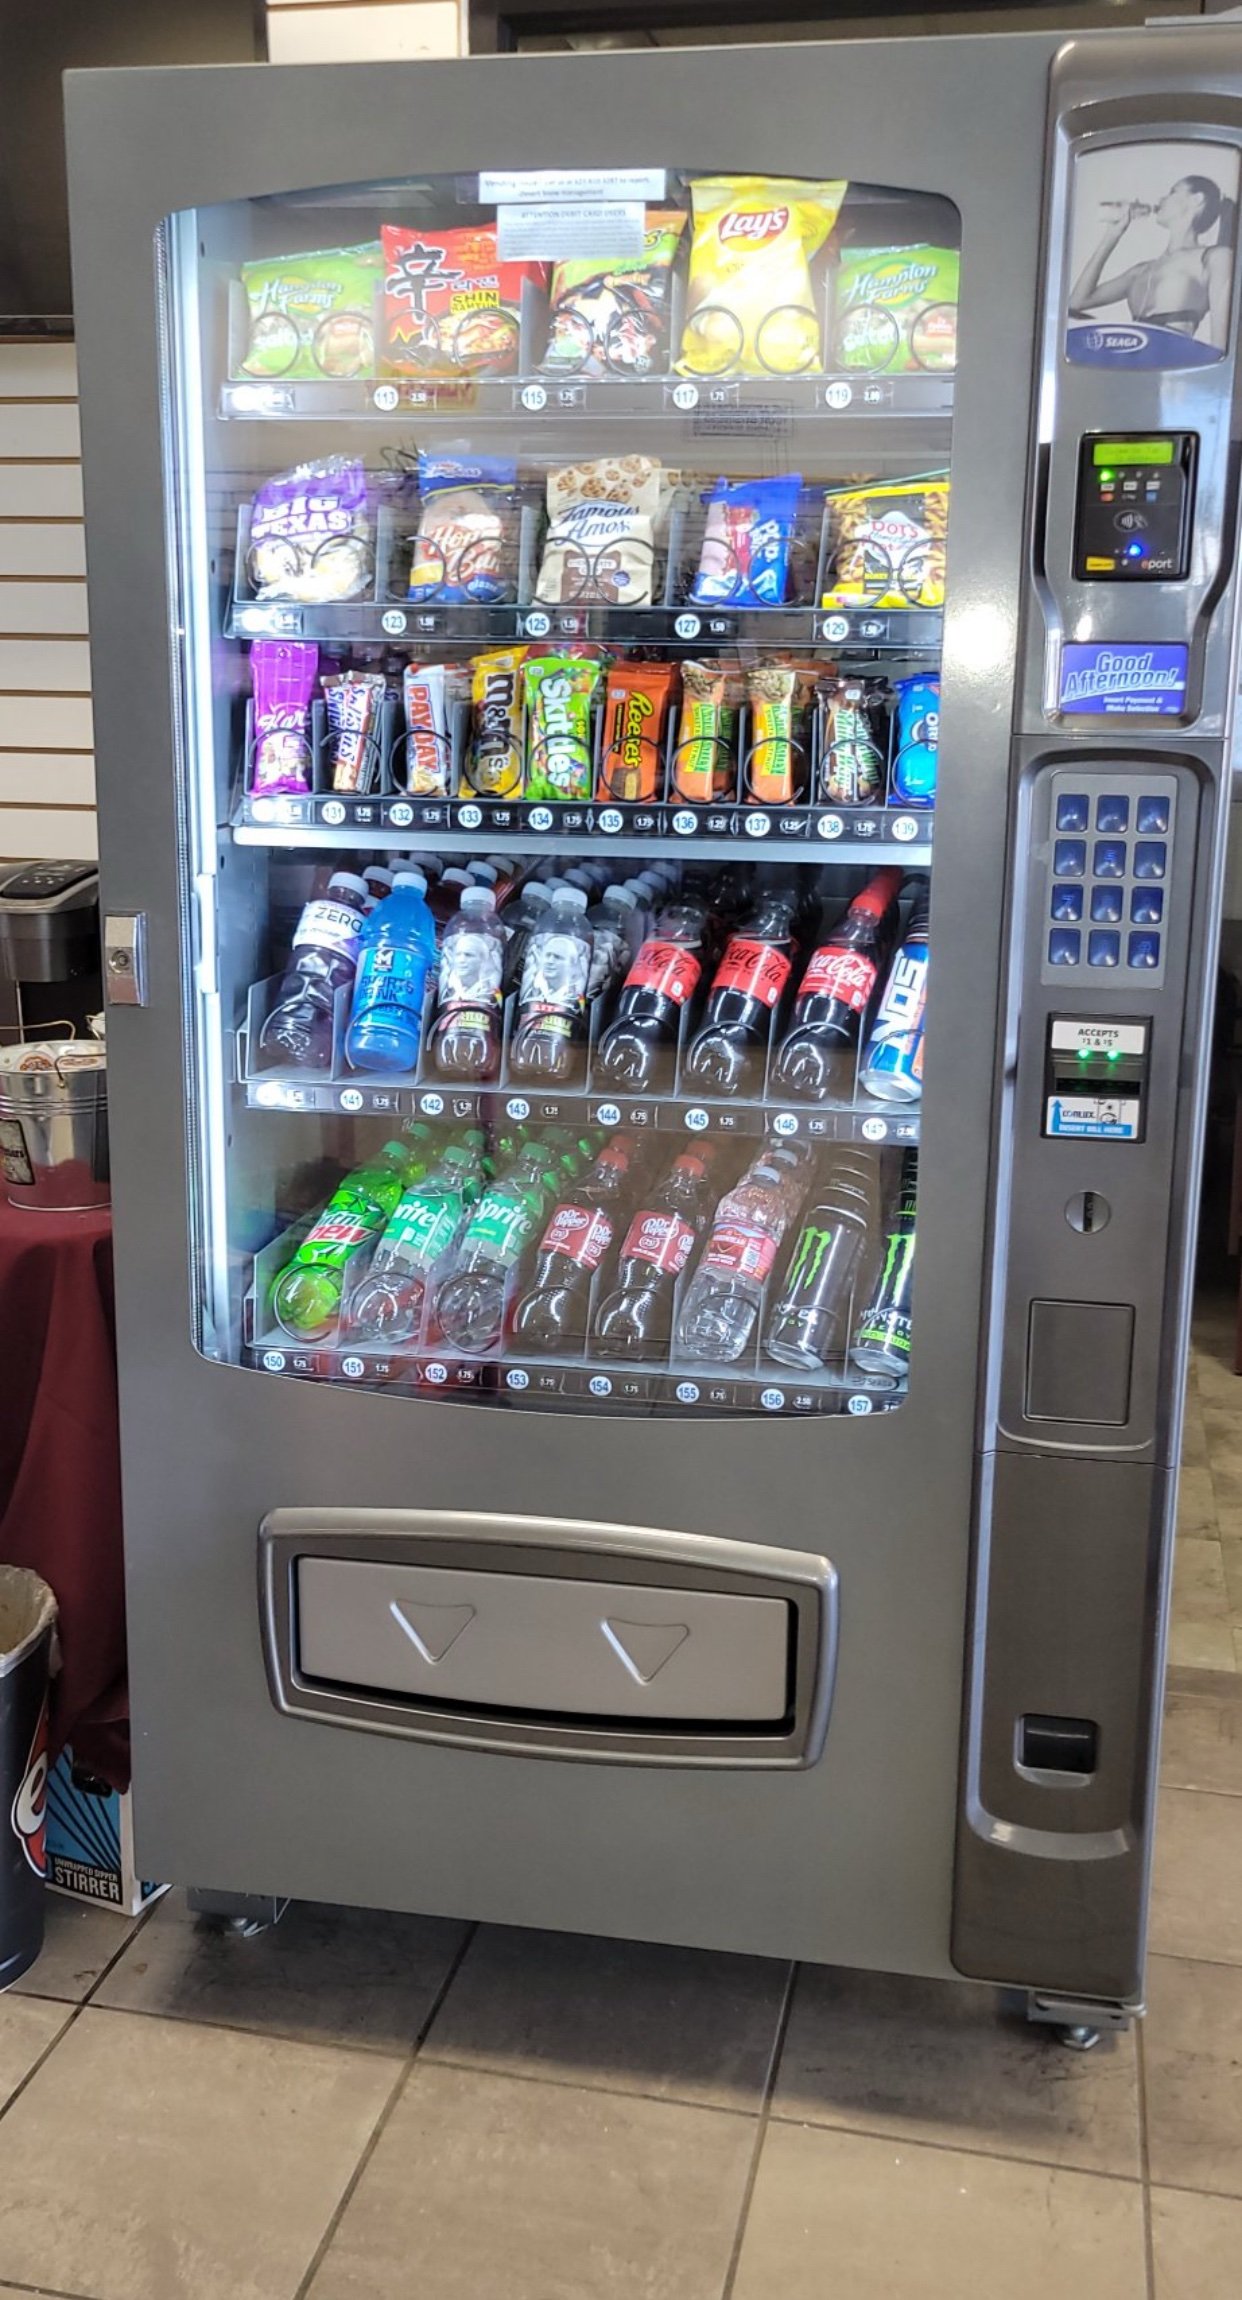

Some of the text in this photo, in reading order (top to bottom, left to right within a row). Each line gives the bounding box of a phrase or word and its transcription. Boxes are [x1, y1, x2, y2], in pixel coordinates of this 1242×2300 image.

[721, 209, 788, 241] Lay's
[842, 262, 937, 305] Hampton
[453, 292, 497, 304] SHIN
[863, 280, 928, 304] Farms
[376, 391, 396, 403] 113
[523, 391, 545, 404] 115
[675, 390, 695, 403] 117
[262, 496, 339, 522] BIG
[557, 502, 640, 525] Famous
[251, 510, 351, 539] TEXAS
[555, 519, 631, 547] Amos
[384, 616, 405, 629] 123
[527, 617, 547, 631] 125
[678, 619, 697, 632] 127
[826, 622, 845, 635] 129
[1097, 651, 1153, 673] Good
[1064, 667, 1179, 699] Afternoon!
[406, 684, 441, 774] PAYDAY
[540, 677, 577, 787] Skittles
[624, 690, 654, 769] Reese's
[324, 806, 342, 819] 131
[392, 808, 411, 821] 132
[461, 810, 479, 822] 133
[531, 813, 549, 825] 134
[601, 814, 620, 827] 135
[675, 817, 695, 829] 136
[747, 818, 766, 831] 137
[820, 820, 840, 833] 138
[896, 822, 914, 835] 139
[314, 907, 364, 934] ZERO
[871, 957, 926, 1054] NOS
[1078, 1028, 1119, 1038] ACCEPTS
[343, 1094, 360, 1106] 141
[422, 1098, 442, 1111] 142
[508, 1103, 527, 1115] 143
[600, 1108, 618, 1121] 144
[687, 1113, 706, 1126] 145
[776, 1118, 795, 1131] 146
[394, 1200, 438, 1227] rite
[475, 1197, 533, 1235] Sprite
[265, 1355, 283, 1367] 150
[344, 1361, 362, 1373] 151
[427, 1367, 445, 1379] 152
[508, 1373, 527, 1385] 153
[591, 1380, 609, 1392] 154
[678, 1386, 696, 1399] 155
[763, 1393, 782, 1406] 156
[851, 1400, 869, 1412] 157
[55, 1866, 120, 1901] STIRRER
